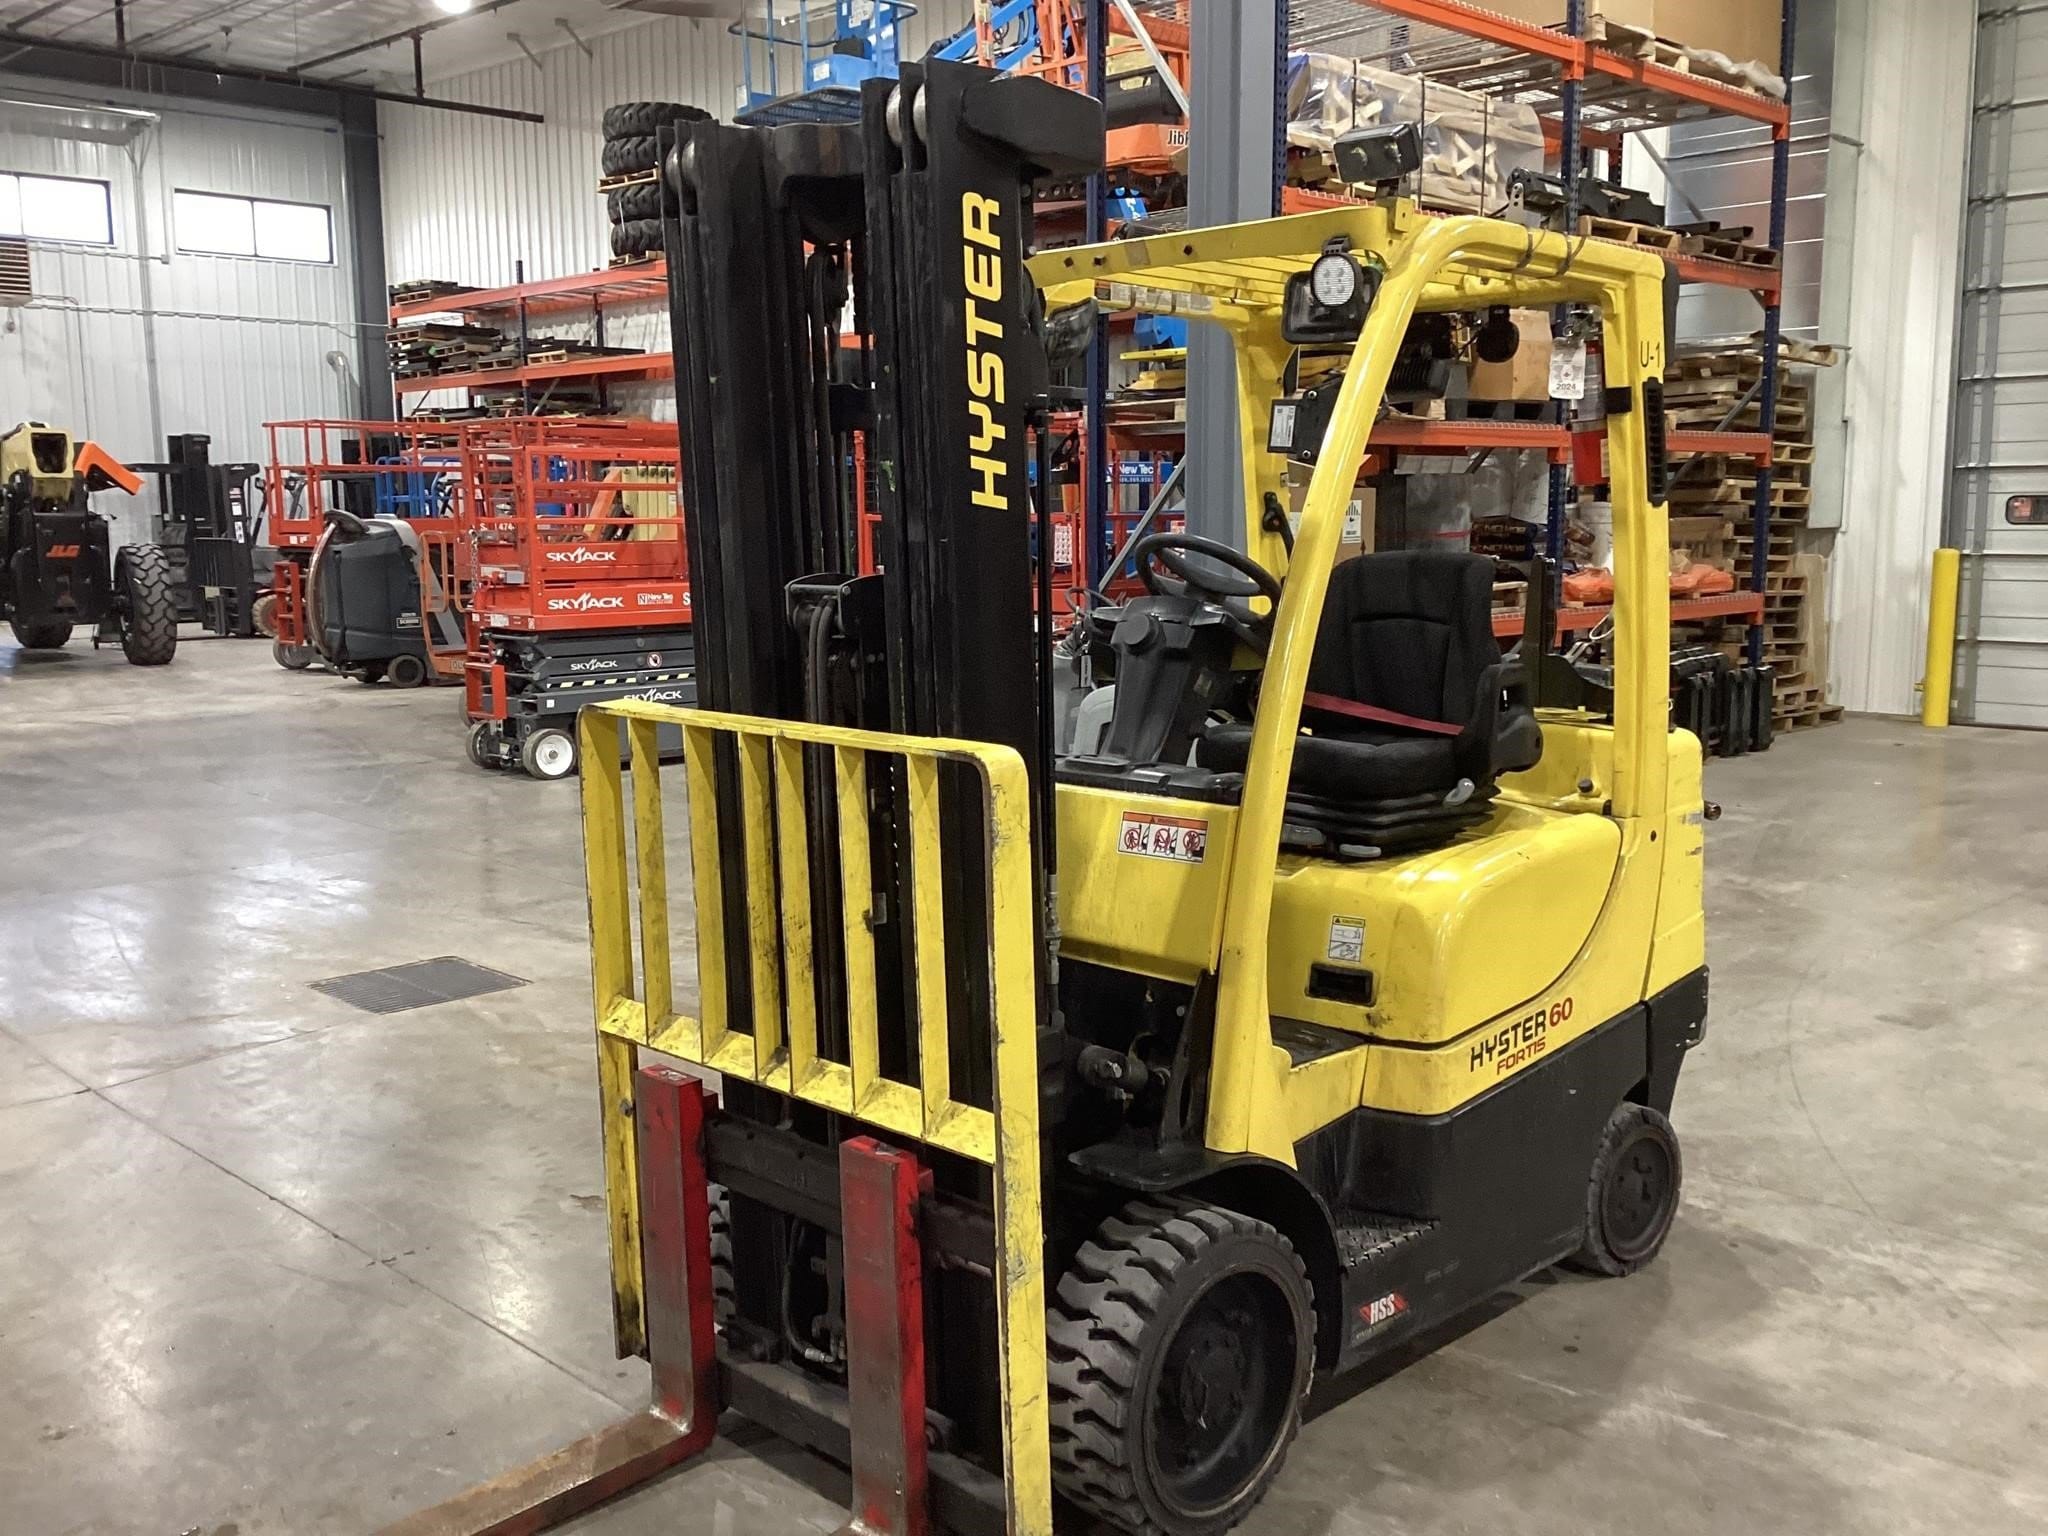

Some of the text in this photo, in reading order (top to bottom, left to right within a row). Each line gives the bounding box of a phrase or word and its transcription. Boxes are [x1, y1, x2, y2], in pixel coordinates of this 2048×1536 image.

[962, 191, 1008, 510] HYSTER
[1119, 464, 1138, 474] New
[546, 547, 617, 563] SKYJACK
[547, 592, 624, 611] SKYJACK
[570, 658, 618, 671] SKYJACK
[1470, 997, 1574, 1073] HYSTER 60
[1496, 1036, 1546, 1076] FORTIS
[1370, 1293, 1395, 1325] HSS
